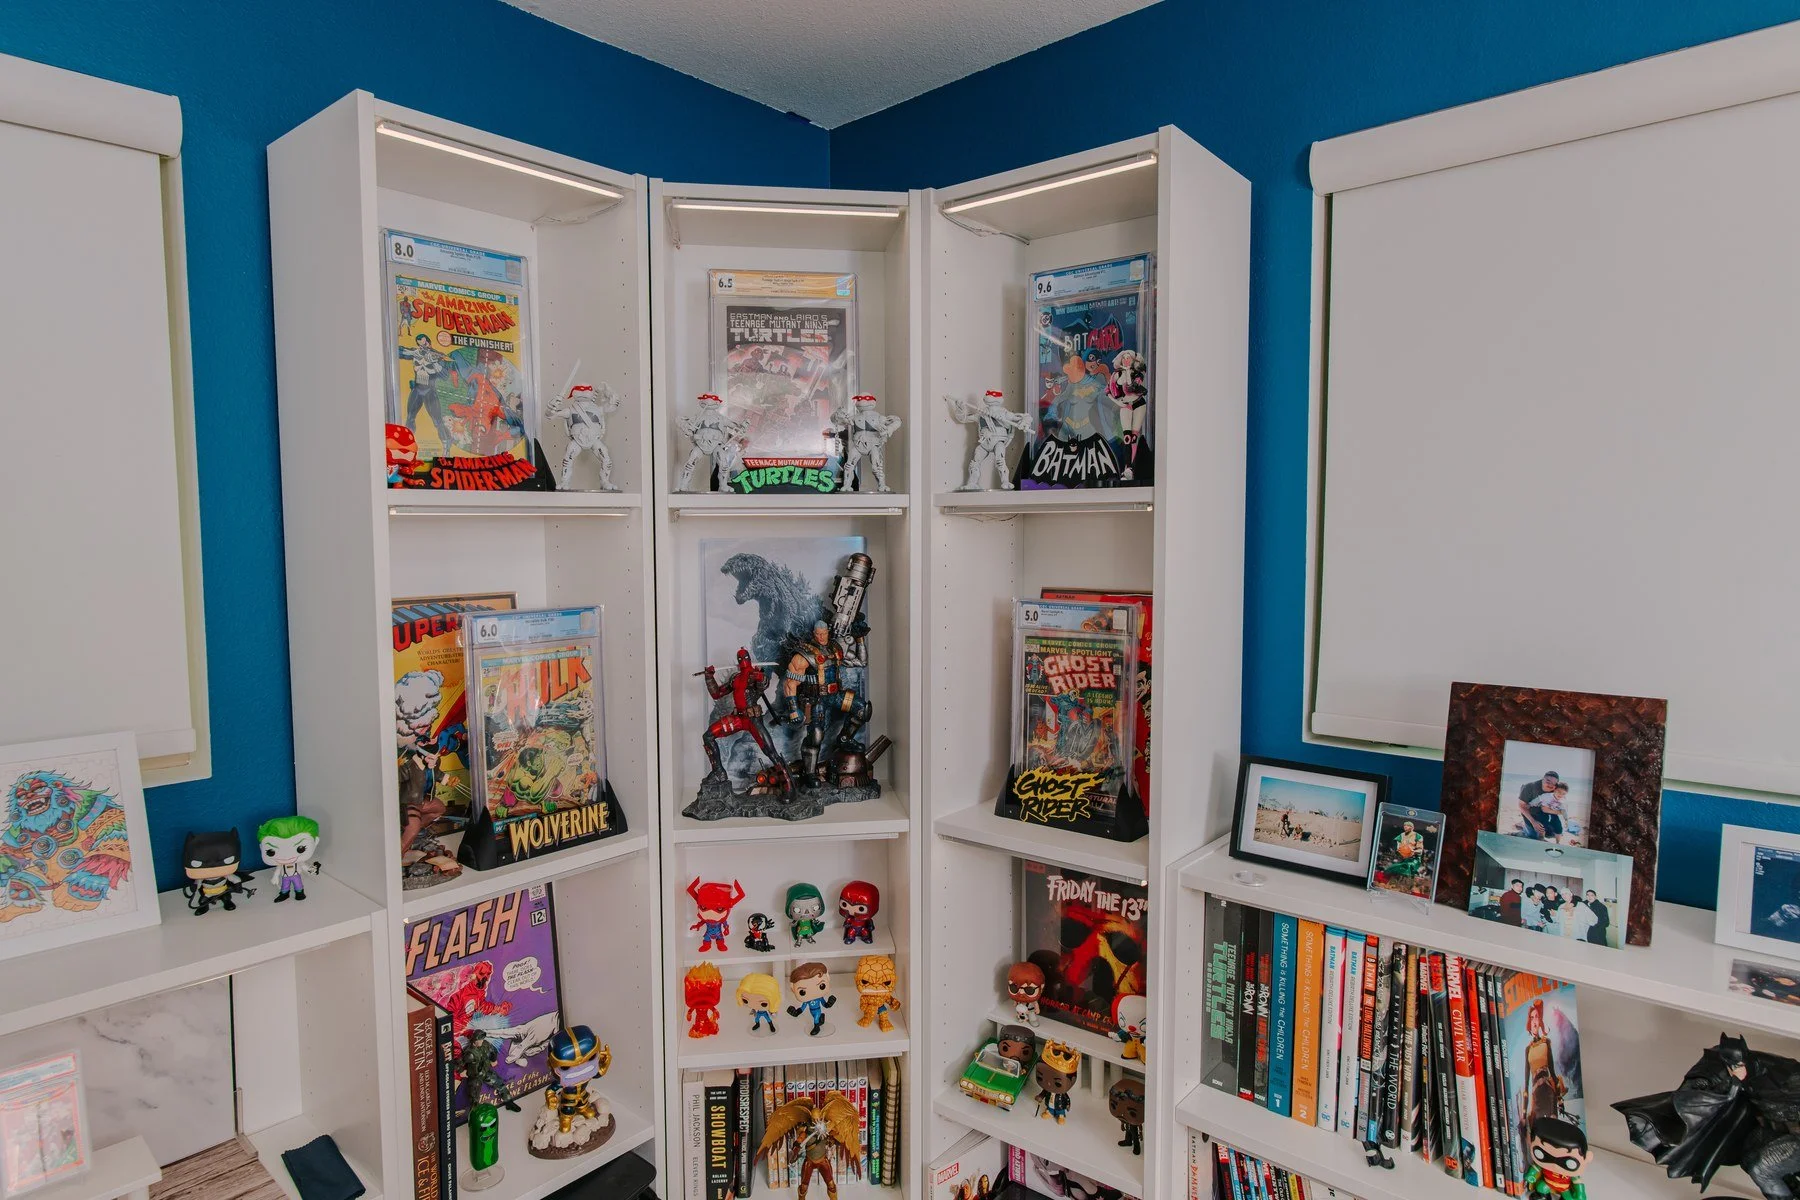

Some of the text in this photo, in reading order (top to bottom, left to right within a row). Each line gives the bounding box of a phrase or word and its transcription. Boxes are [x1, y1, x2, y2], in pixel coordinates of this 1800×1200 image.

[394, 242, 414, 258] 8.0
[418, 281, 447, 292] MARVEL
[448, 285, 475, 297] COMICS
[477, 290, 501, 300] GROUP
[718, 278, 733, 288] 6.5
[1037, 281, 1052, 294] 9.6
[411, 298, 516, 335] SPIDER-MAN
[436, 294, 496, 314] AMAZING
[730, 320, 829, 330] TEENAGE MUTANT NINJA
[730, 328, 829, 343] TURTLES
[453, 335, 513, 352] THE PUNISHER!
[430, 458, 538, 490] SPIDER-MAN
[453, 451, 515, 469] AMAZING
[1032, 440, 1117, 481] BATMAN
[732, 465, 835, 494] TURTLES
[1025, 610, 1039, 622] 5.0
[392, 612, 460, 652] UPER
[480, 624, 497, 638] 6.0
[1040, 646, 1112, 657] MARVEL SPOTLIGHT
[1043, 655, 1113, 674] GHOST
[1049, 674, 1116, 694] RIDER
[1016, 773, 1091, 798] GHOST
[1020, 797, 1091, 822] RIDER
[509, 802, 610, 858] WOLVERINE
[1046, 875, 1097, 903] FRIDAY
[1094, 890, 1121, 912] THE
[405, 888, 524, 977] FLASH
[1279, 922, 1290, 968] SOMETHING
[1303, 930, 1314, 977] SOMETHING
[1328, 945, 1337, 969] BATMAN
[1350, 951, 1358, 975] BATMAN
[1365, 957, 1378, 992] BATMAN
[1419, 961, 1428, 992] MARVEL
[1210, 941, 1228, 1041] TURTLES
[1224, 944, 1236, 1044] TEENAGE MUTANT NINJA
[1242, 987, 1256, 1016] RONIN
[1256, 990, 1270, 1018] RONIN
[1278, 977, 1287, 1005] KILLING
[1302, 986, 1312, 1014] KILLING
[1278, 1007, 1286, 1018] the
[1363, 1006, 1374, 1023] LONG
[1444, 954, 1466, 1063] MARVEL CIVIL WAR
[413, 1022, 426, 1071] MARTIN
[424, 1018, 433, 1049] GEORGE
[1275, 1019, 1285, 1060] CHILDREN
[1361, 1023, 1373, 1060] HALLOWEEN
[1404, 1030, 1413, 1045] THE
[1470, 1021, 1480, 1058] infidel
[441, 1042, 453, 1062] BAIT
[1300, 1029, 1310, 1070] CHILDREN
[1386, 994, 1401, 1110] BATMAN THE WORLD
[1404, 1045, 1412, 1063] JUST
[738, 1079, 750, 1134] DRDISRESPECT
[1275, 1098, 1280, 1108] 1
[1300, 1110, 1307, 1119] 2
[692, 1094, 701, 1148] PHIL JACKSON
[710, 1105, 726, 1169] SHOWBOAT
[417, 1157, 430, 1187] ICE &
[429, 1164, 438, 1195] WORLD
[937, 1162, 959, 1185] MARVEL
